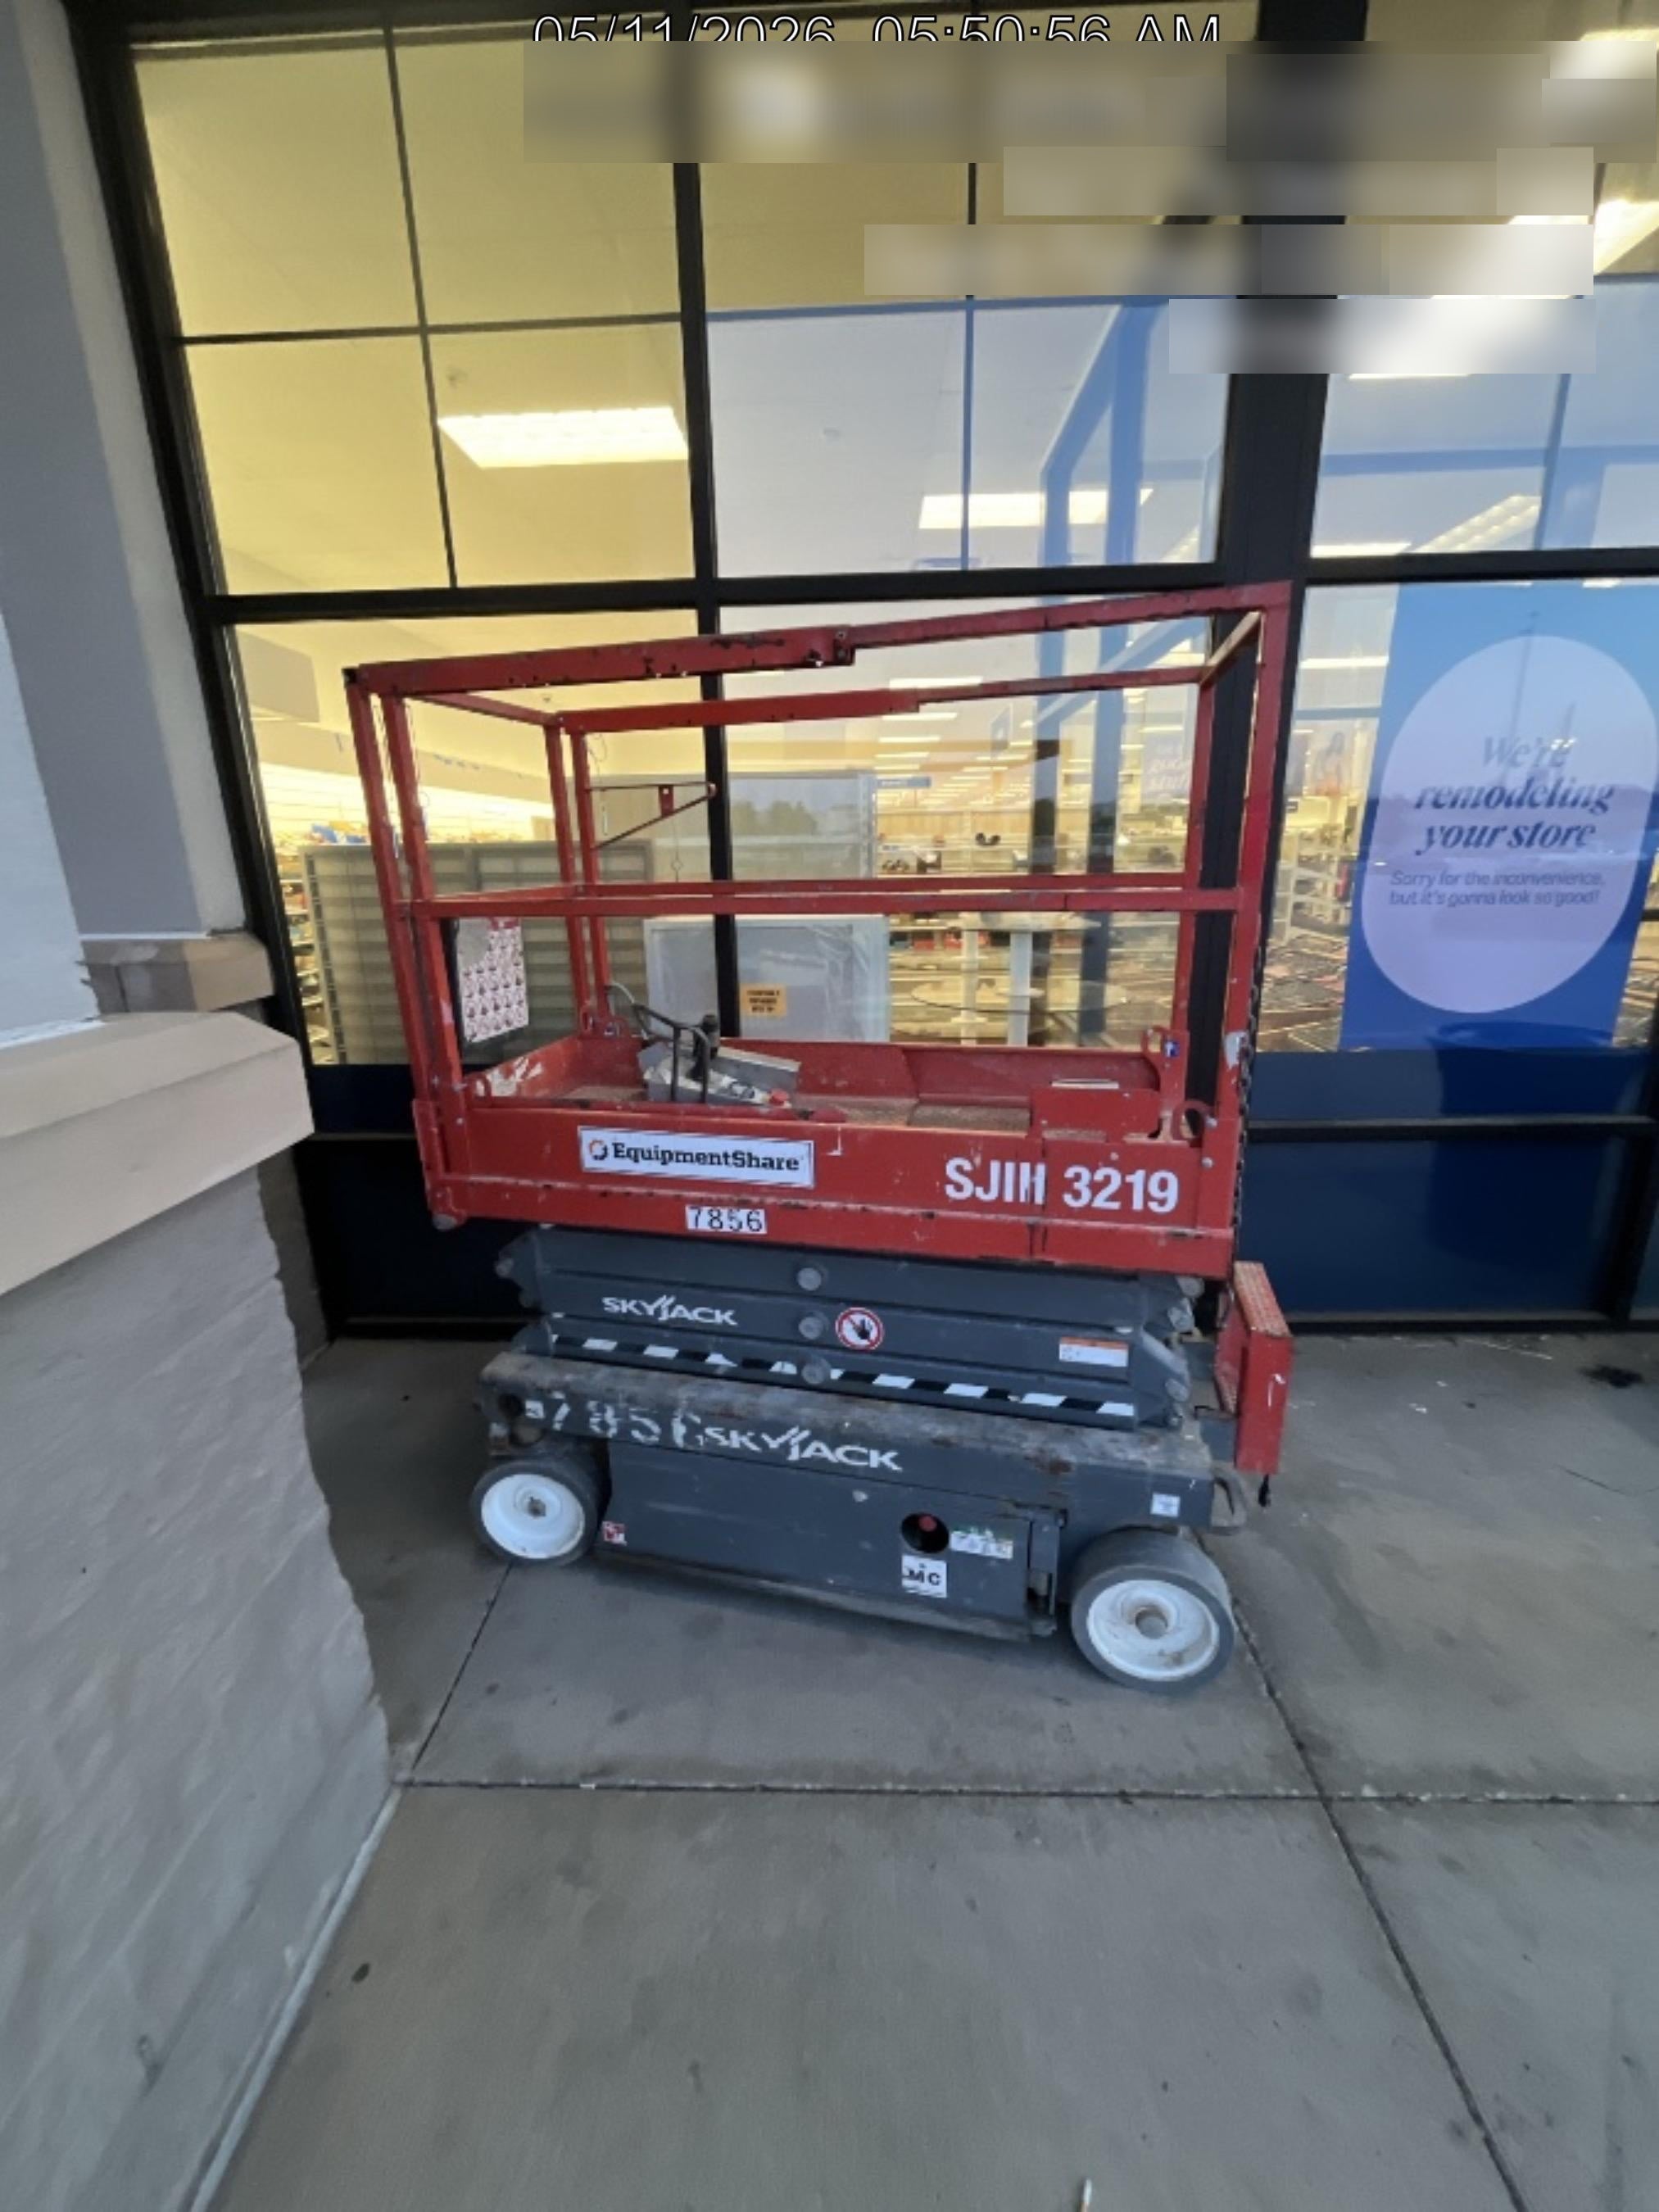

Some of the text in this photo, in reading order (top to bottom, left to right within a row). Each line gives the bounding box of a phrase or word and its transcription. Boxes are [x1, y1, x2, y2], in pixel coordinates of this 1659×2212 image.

[1413, 778, 1613, 814] remodeling
[1415, 822, 1596, 856] your store
[1392, 870, 1437, 887] Sorry
[1437, 870, 1463, 886] for
[1464, 872, 1491, 886] the
[1389, 891, 1601, 908] but it's gonna look so good!
[612, 1142, 800, 1172] EquipmentShare
[1063, 1165, 1180, 1213] 3219
[690, 1206, 763, 1232] 7856
[601, 1295, 737, 1326] SKYJACK
[705, 1426, 902, 1472] SKYJACK
